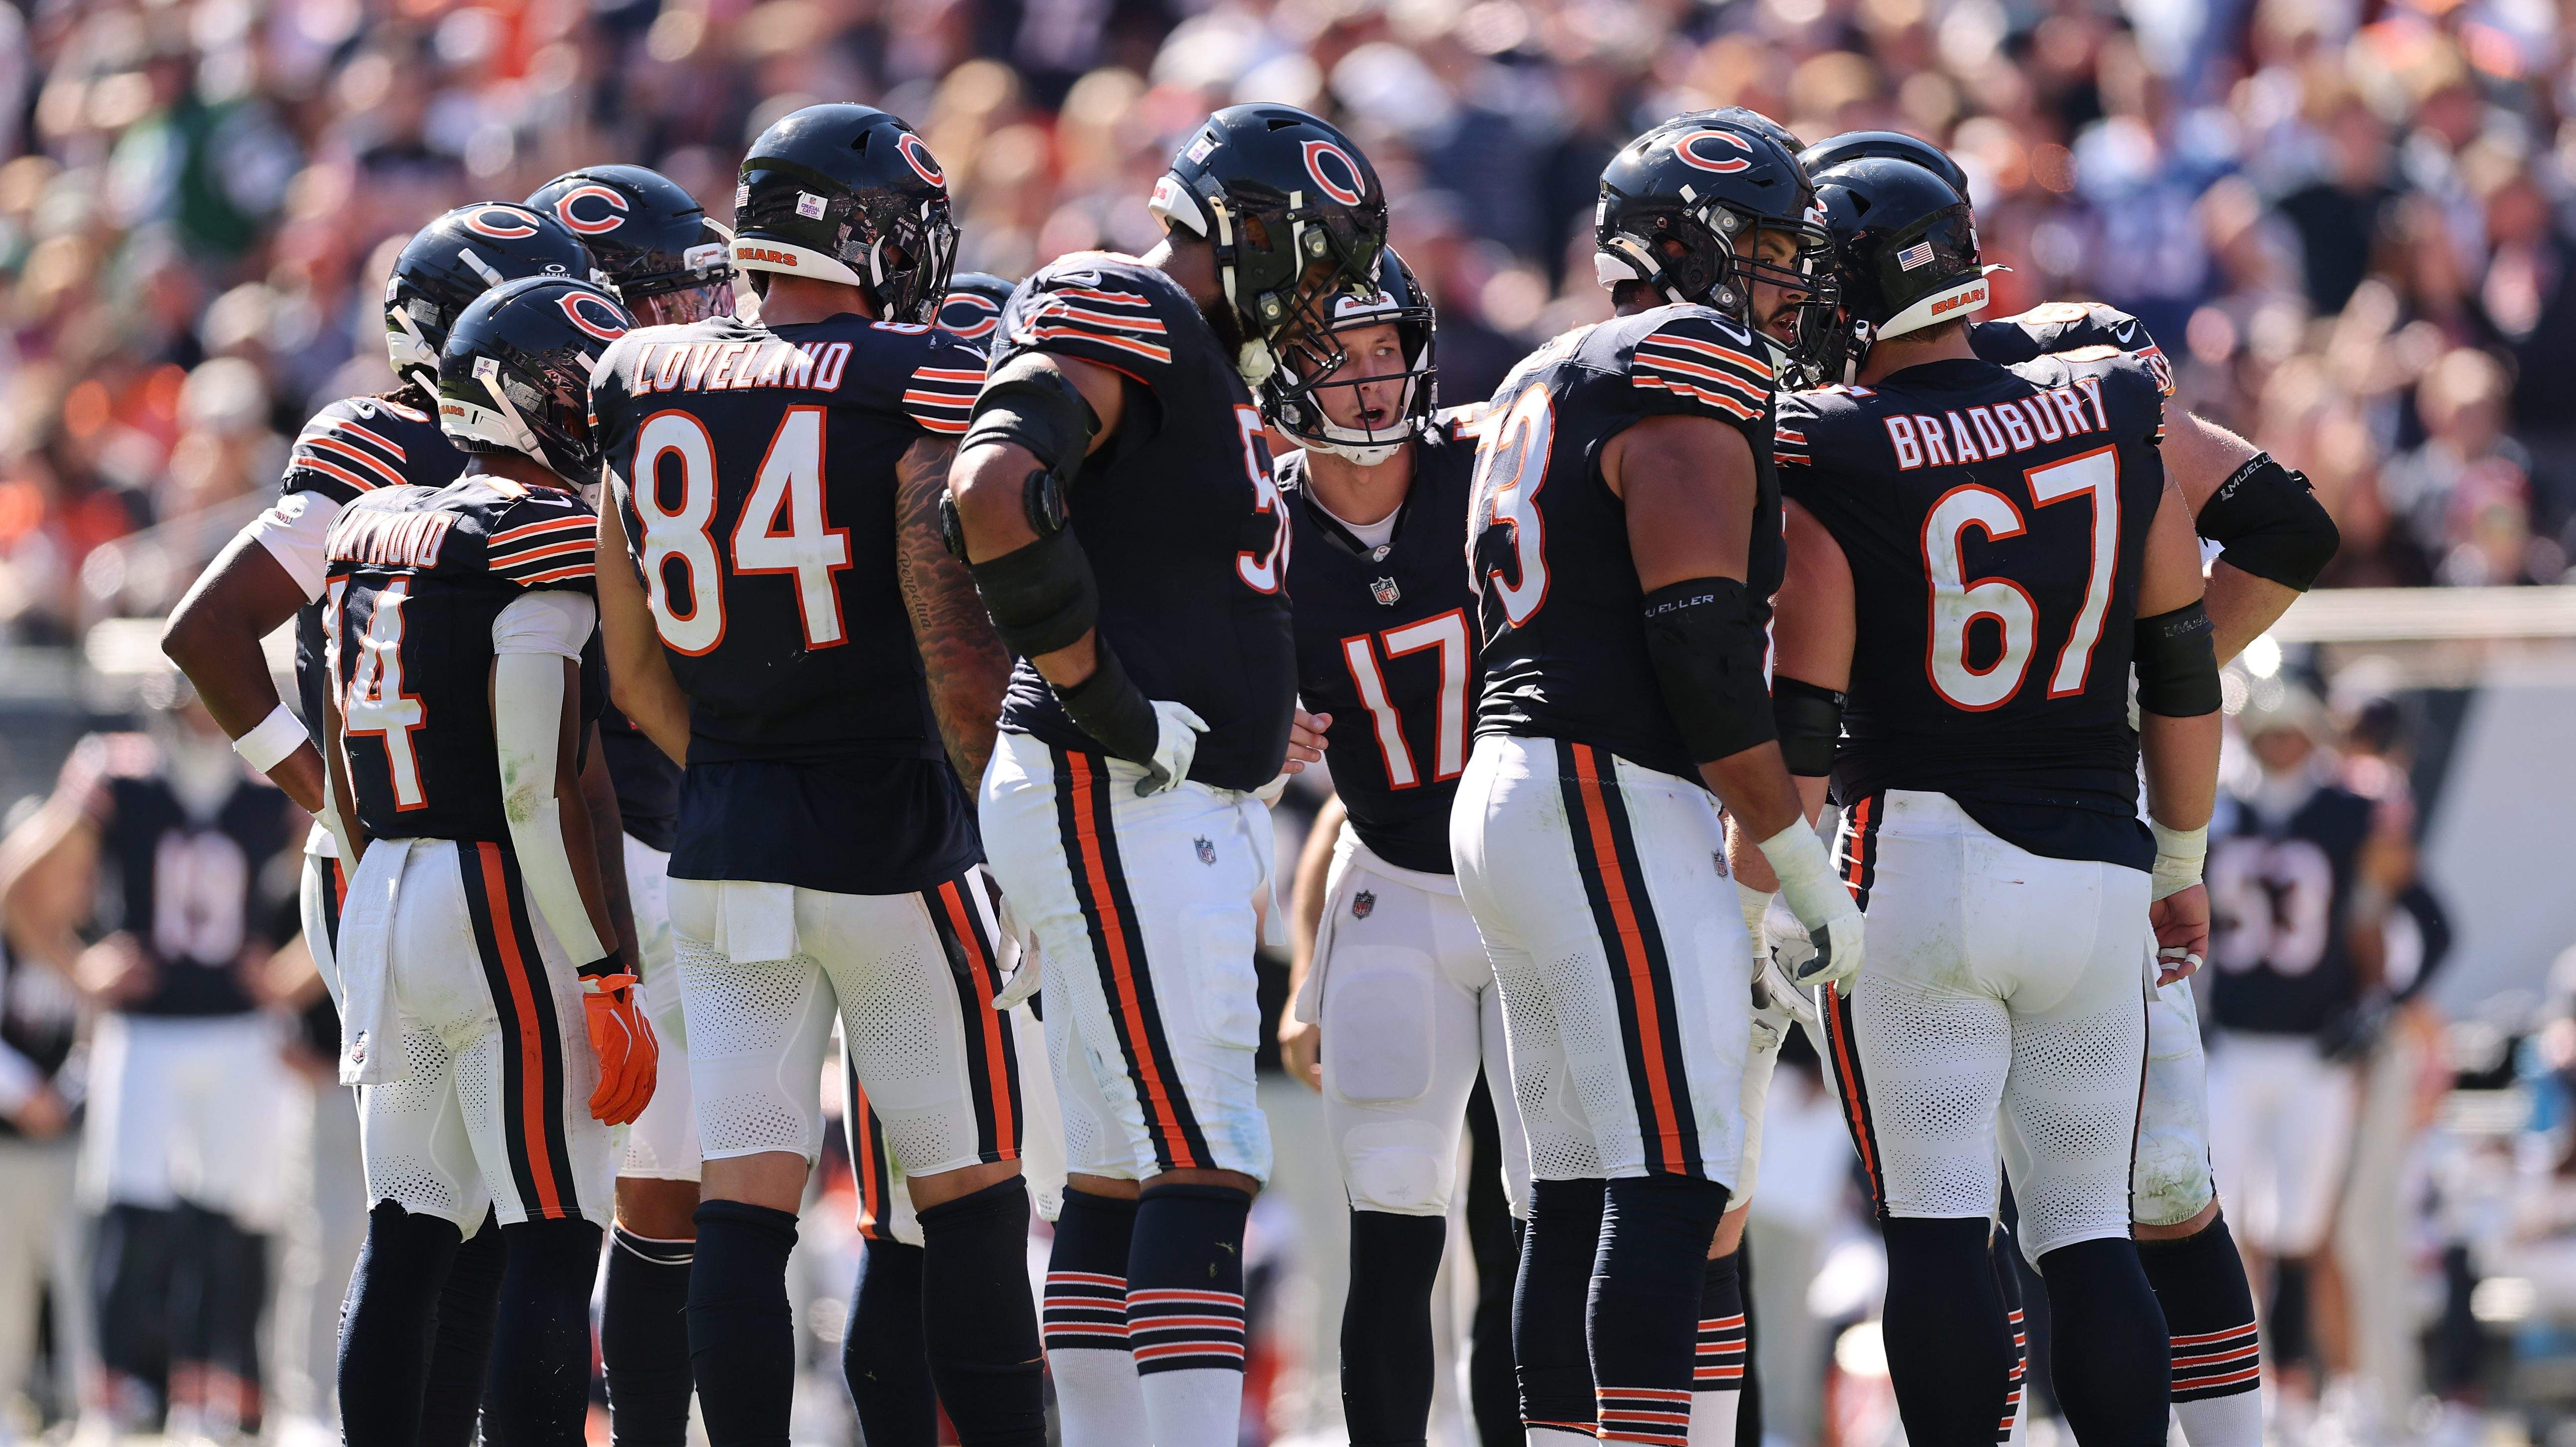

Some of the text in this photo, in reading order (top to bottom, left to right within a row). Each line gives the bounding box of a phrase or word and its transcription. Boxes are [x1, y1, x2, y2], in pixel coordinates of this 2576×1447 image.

[463, 205, 540, 240] C
[554, 185, 629, 235] C
[801, 203, 820, 212] CRUCIAL
[736, 247, 797, 266] BEARS
[1345, 296, 1388, 309] BES
[1932, 288, 1985, 316] BEARS
[632, 342, 854, 397] LOVELAND
[1883, 376, 2109, 470] BRADBURY
[1233, 403, 1292, 594] 5
[2228, 454, 2273, 492] MUELLE
[631, 404, 854, 657] 84
[1378, 589, 1397, 601] NFL
[1920, 443, 2121, 711] 67
[323, 574, 427, 815] 14
[1341, 607, 1471, 791] 17
[2207, 837, 2333, 977] 53
